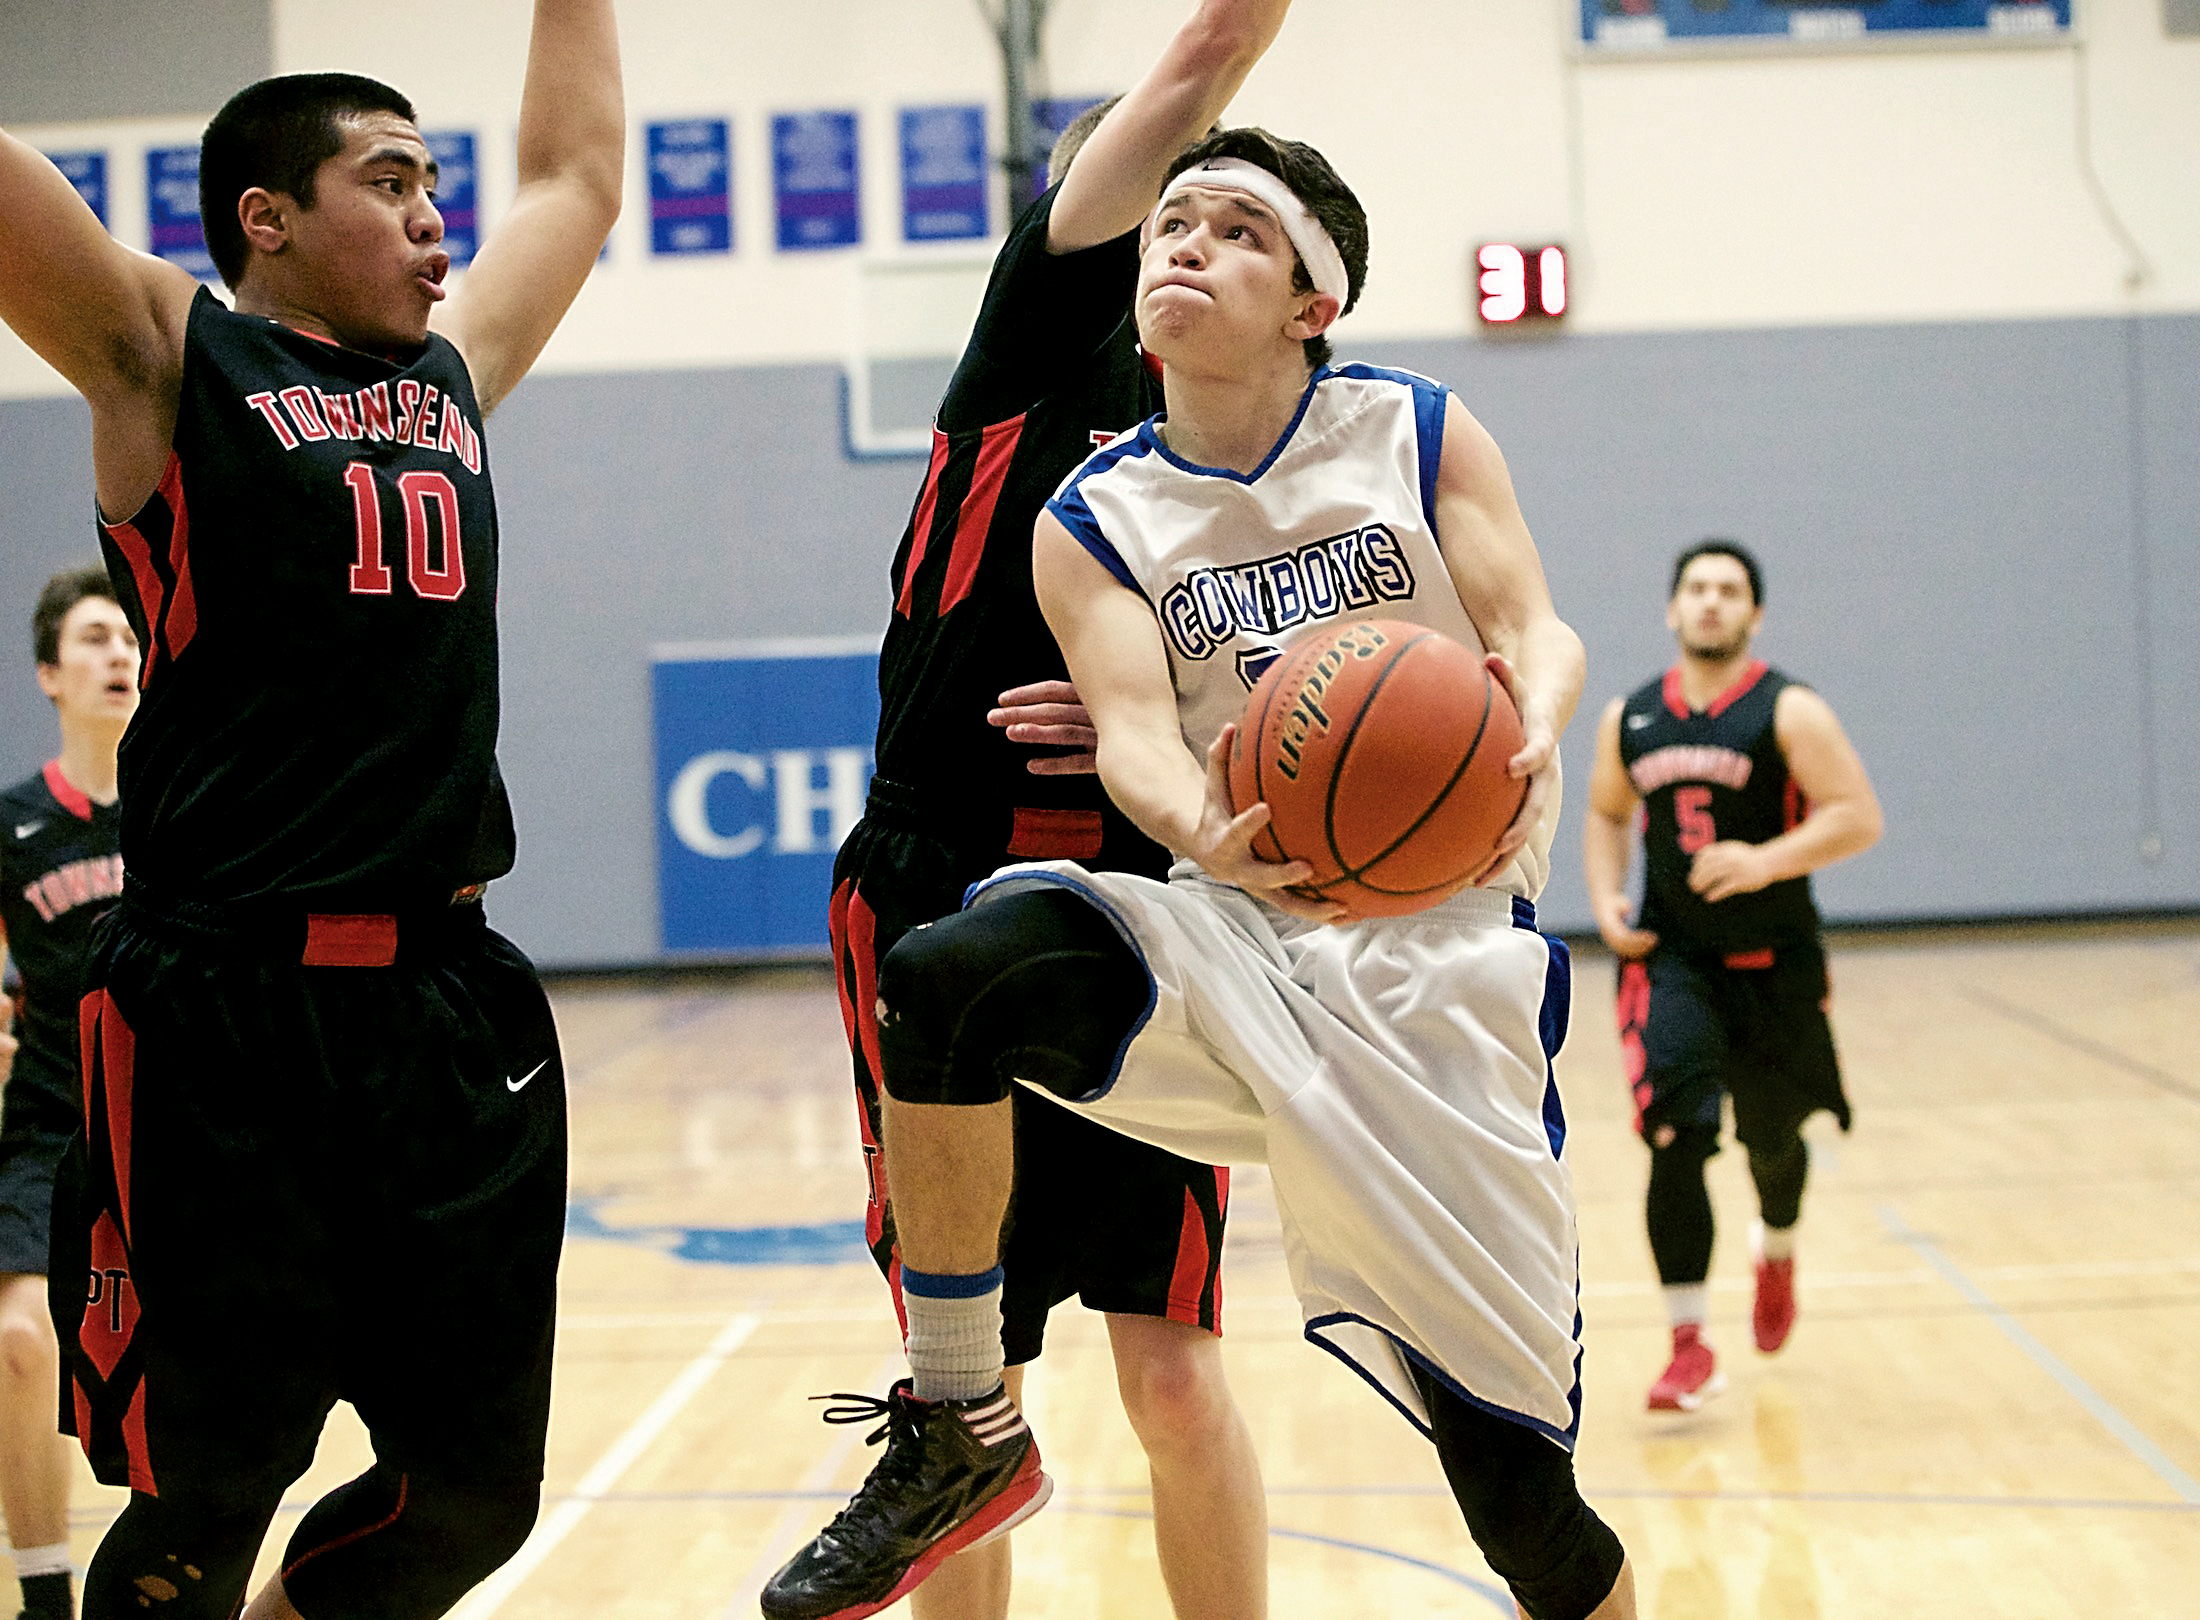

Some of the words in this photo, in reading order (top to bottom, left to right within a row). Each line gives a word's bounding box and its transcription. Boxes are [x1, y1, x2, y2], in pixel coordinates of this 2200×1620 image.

[1478, 243, 1566, 322] 31
[246, 379, 482, 476] TOWNSEND
[344, 462, 466, 601] 10
[1161, 523, 1415, 661] COWBOYS
[1277, 624, 1390, 782] Baden
[1674, 785, 1717, 855] 5
[87, 1267, 129, 1333] PT
